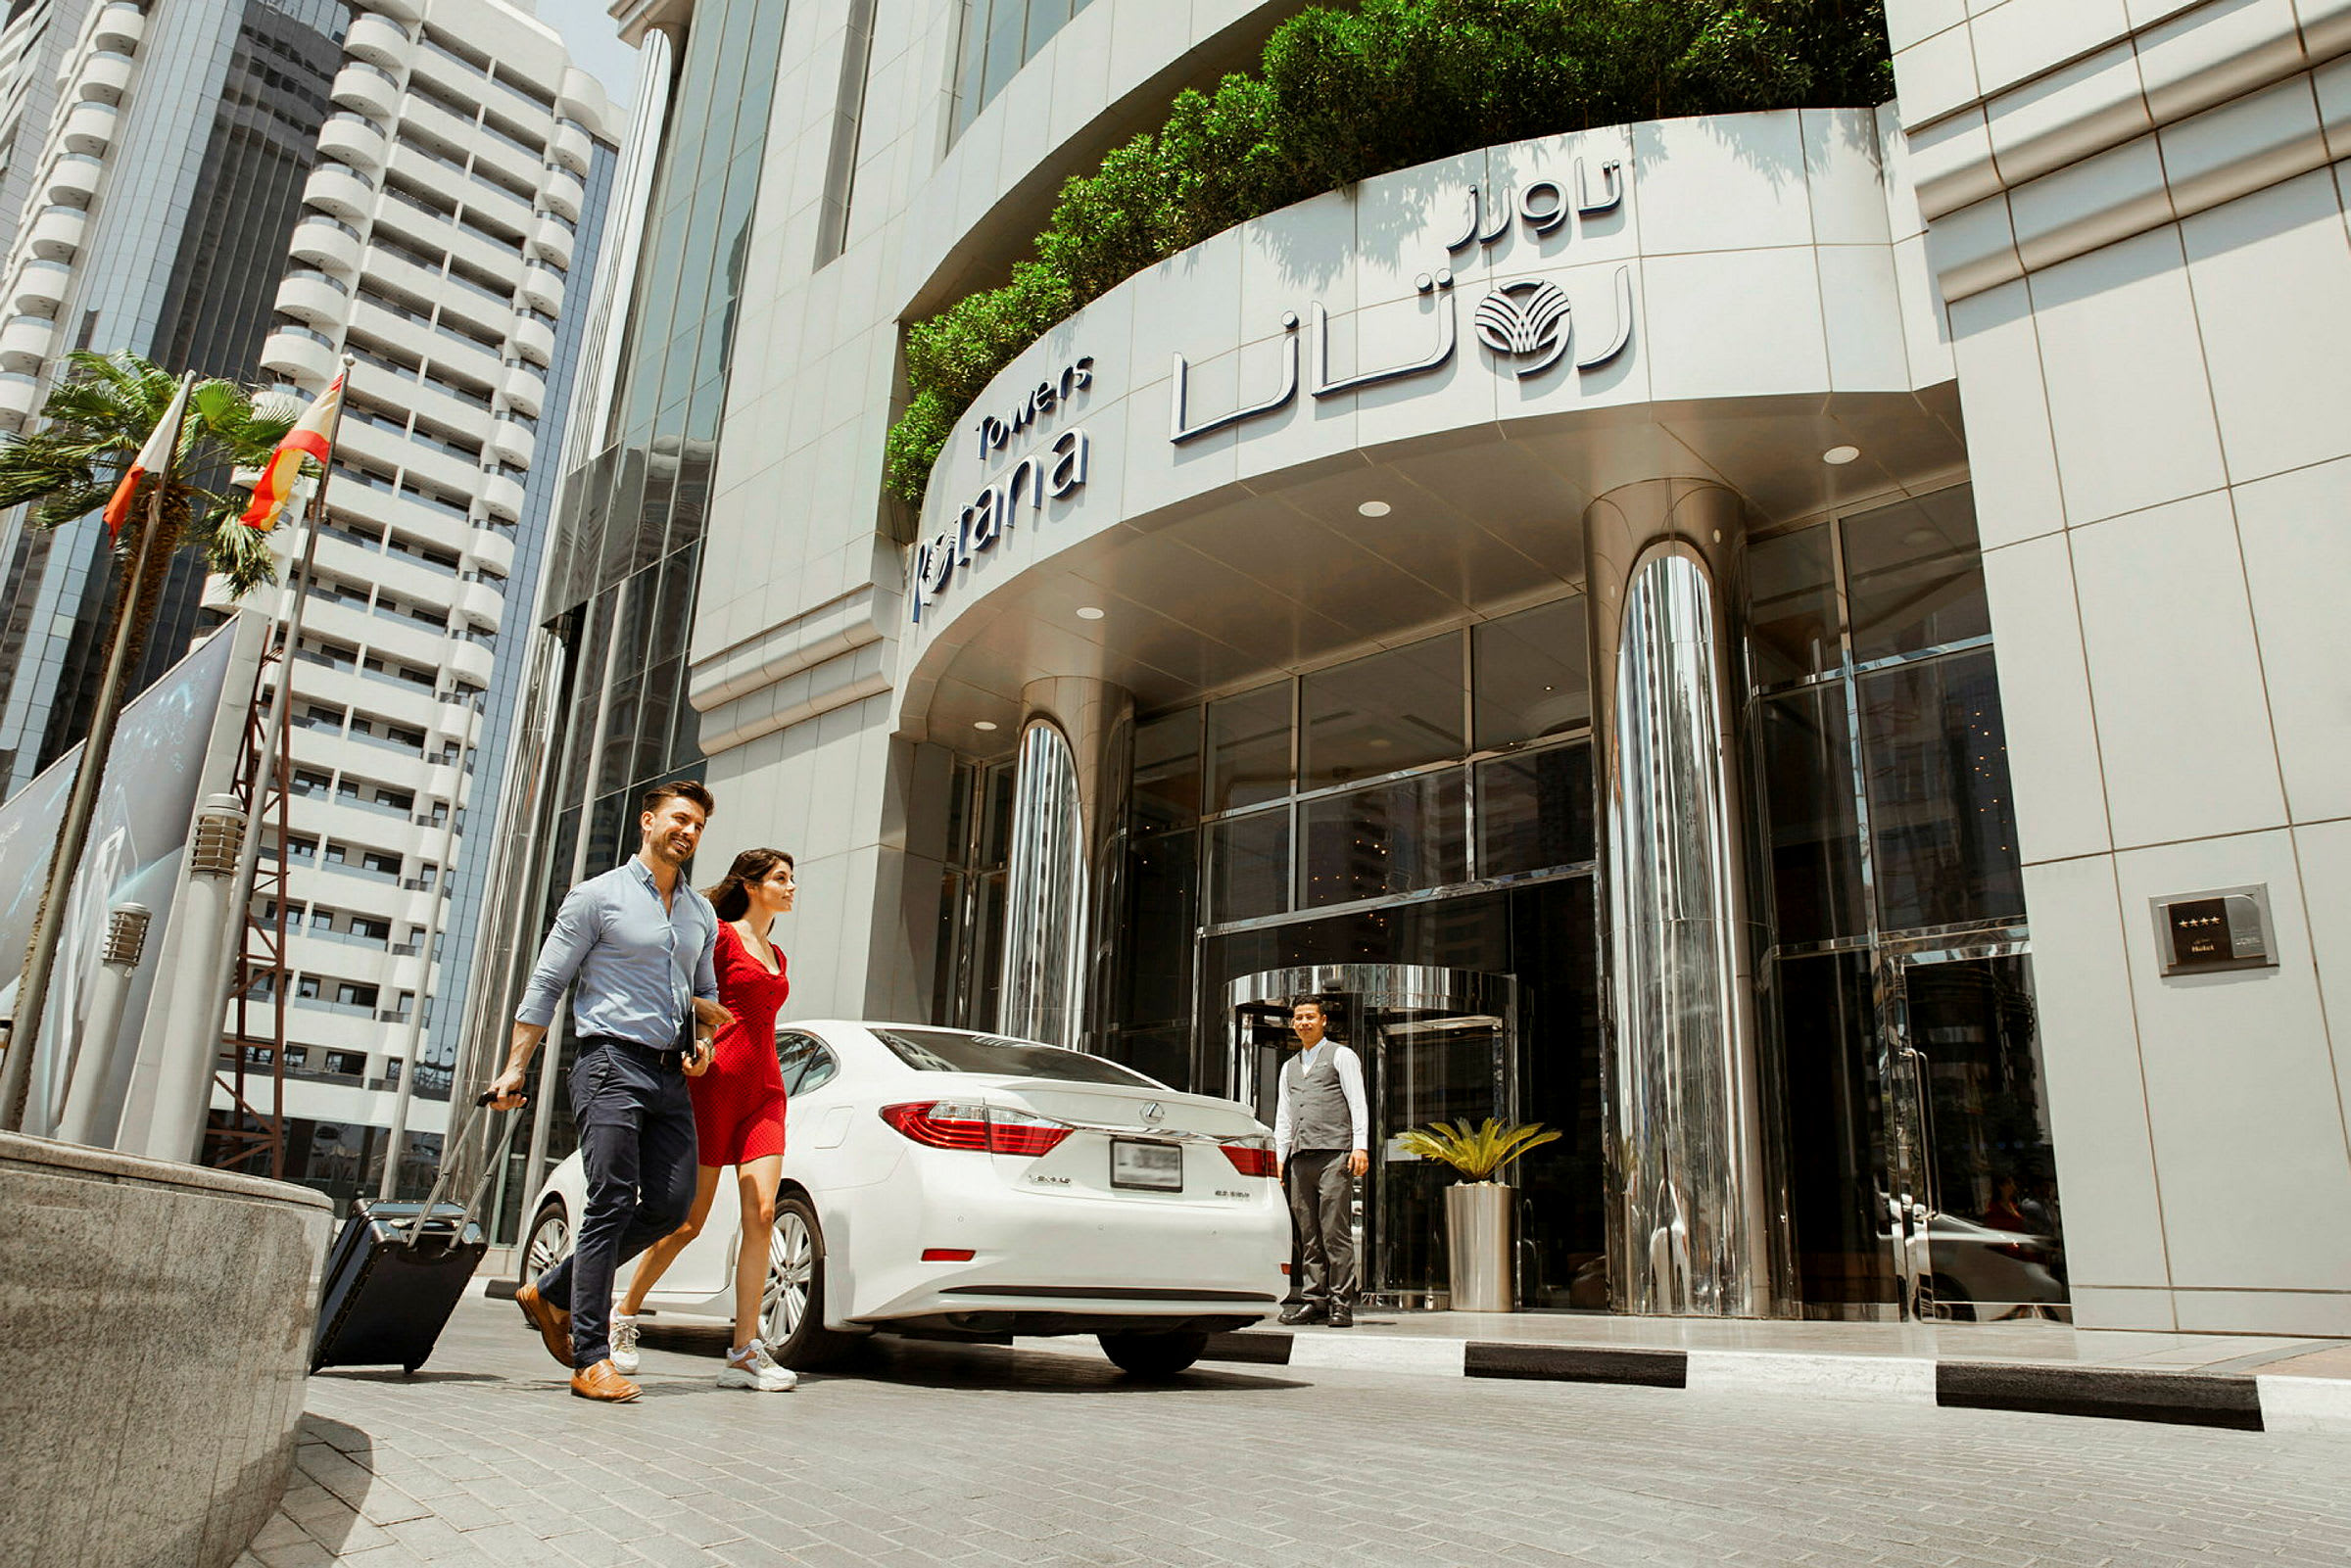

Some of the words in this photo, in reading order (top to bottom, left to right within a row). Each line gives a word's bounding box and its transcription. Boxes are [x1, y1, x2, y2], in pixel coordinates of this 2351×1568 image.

[1446, 157, 1622, 253] تاورز
[975, 356, 1094, 460] Towers
[1170, 264, 1633, 444] روتانا
[912, 427, 1089, 624] Rotana
